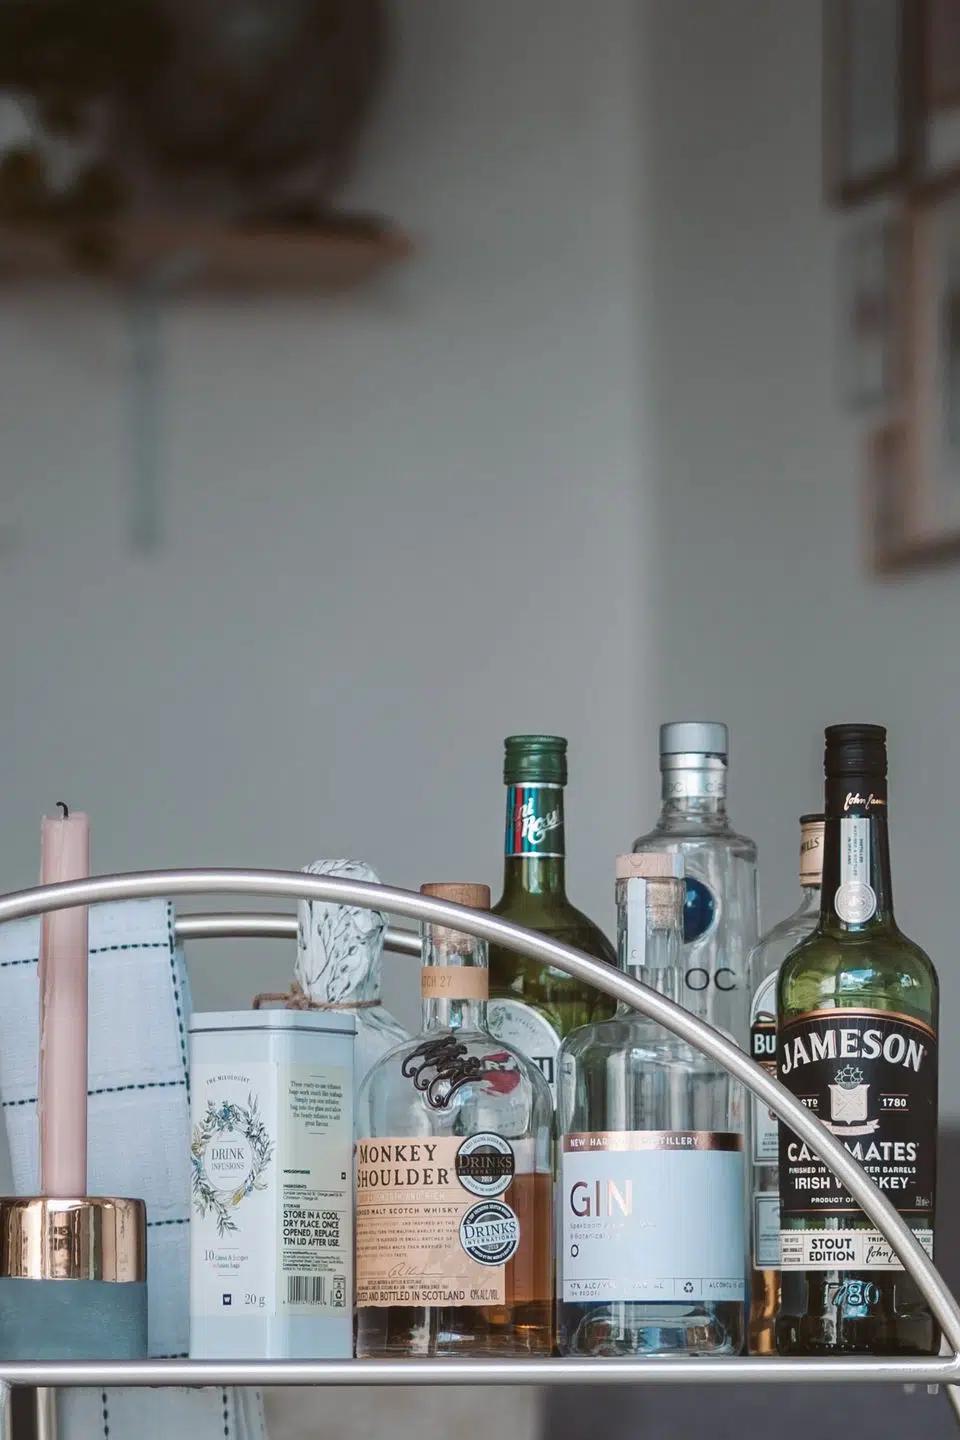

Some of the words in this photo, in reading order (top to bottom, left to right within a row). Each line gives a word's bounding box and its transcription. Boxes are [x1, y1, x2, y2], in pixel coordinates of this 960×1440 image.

[781, 1028, 925, 1075] JAMESON
[882, 1098, 907, 1108] 1780
[570, 1138, 586, 1147] NEW
[211, 1147, 245, 1161] DRINK
[359, 1144, 438, 1164] MONKEY
[211, 1162, 245, 1170] INFUSIONS
[458, 1154, 513, 1169] DRINKS
[788, 1166, 816, 1174] FINISHED
[818, 1166, 826, 1174] IN
[882, 1166, 917, 1174] BARRELS
[356, 1168, 449, 1188] SHOULDER
[794, 1176, 830, 1190] IRISH
[569, 1178, 634, 1217] GIN
[811, 1196, 843, 1204] PRODUCT
[283, 1210, 306, 1219] STORE
[307, 1211, 315, 1219] IN
[315, 1211, 321, 1219] A
[321, 1211, 341, 1221] COOL,
[389, 1207, 420, 1215] SCOTCH
[283, 1219, 299, 1228] DRY
[300, 1220, 321, 1228] PLACE.
[321, 1220, 340, 1229] ONCE
[282, 1228, 314, 1238] OPENED,
[314, 1229, 340, 1238] REPLACE
[463, 1221, 517, 1240] DRINKS
[283, 1237, 296, 1246] TIN
[296, 1238, 307, 1246] LID
[307, 1238, 327, 1247] AFTER
[464, 1232, 517, 1246] INTERNATIONAL
[811, 1238, 853, 1250] STOUT
[204, 1249, 215, 1261] 10
[808, 1251, 856, 1262] EDITION
[244, 1293, 257, 1305] 20
[259, 1296, 266, 1307] g
[368, 1291, 379, 1301] AND
[379, 1290, 410, 1301] BOTTLED
[411, 1290, 420, 1300] IN
[422, 1290, 466, 1300] SCOTLAND
